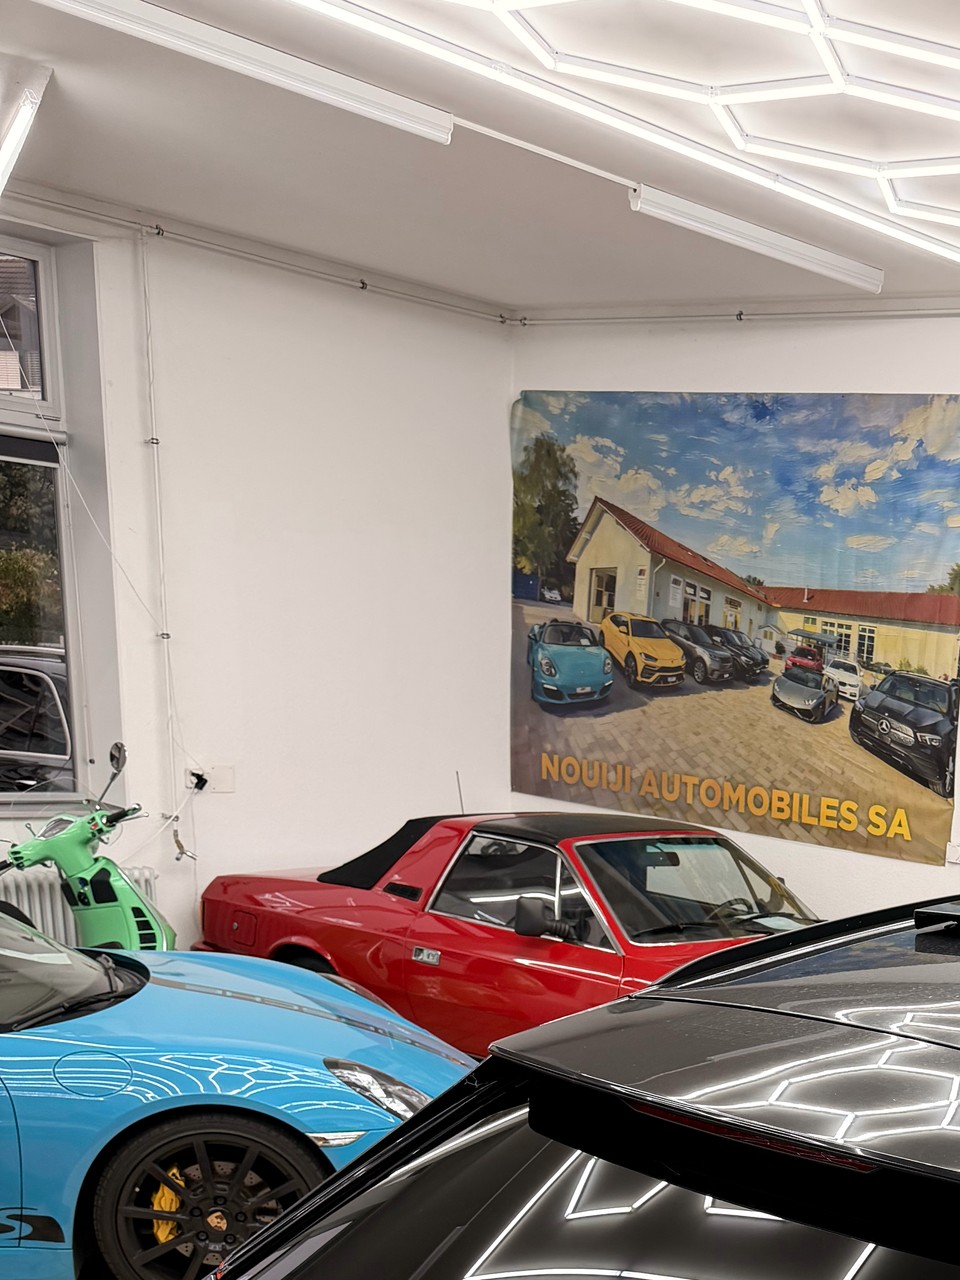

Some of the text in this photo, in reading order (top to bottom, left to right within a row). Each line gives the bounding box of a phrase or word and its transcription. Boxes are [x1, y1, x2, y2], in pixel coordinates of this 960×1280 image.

[541, 752, 912, 841] NOUIJI AUTOMOBILES SA
